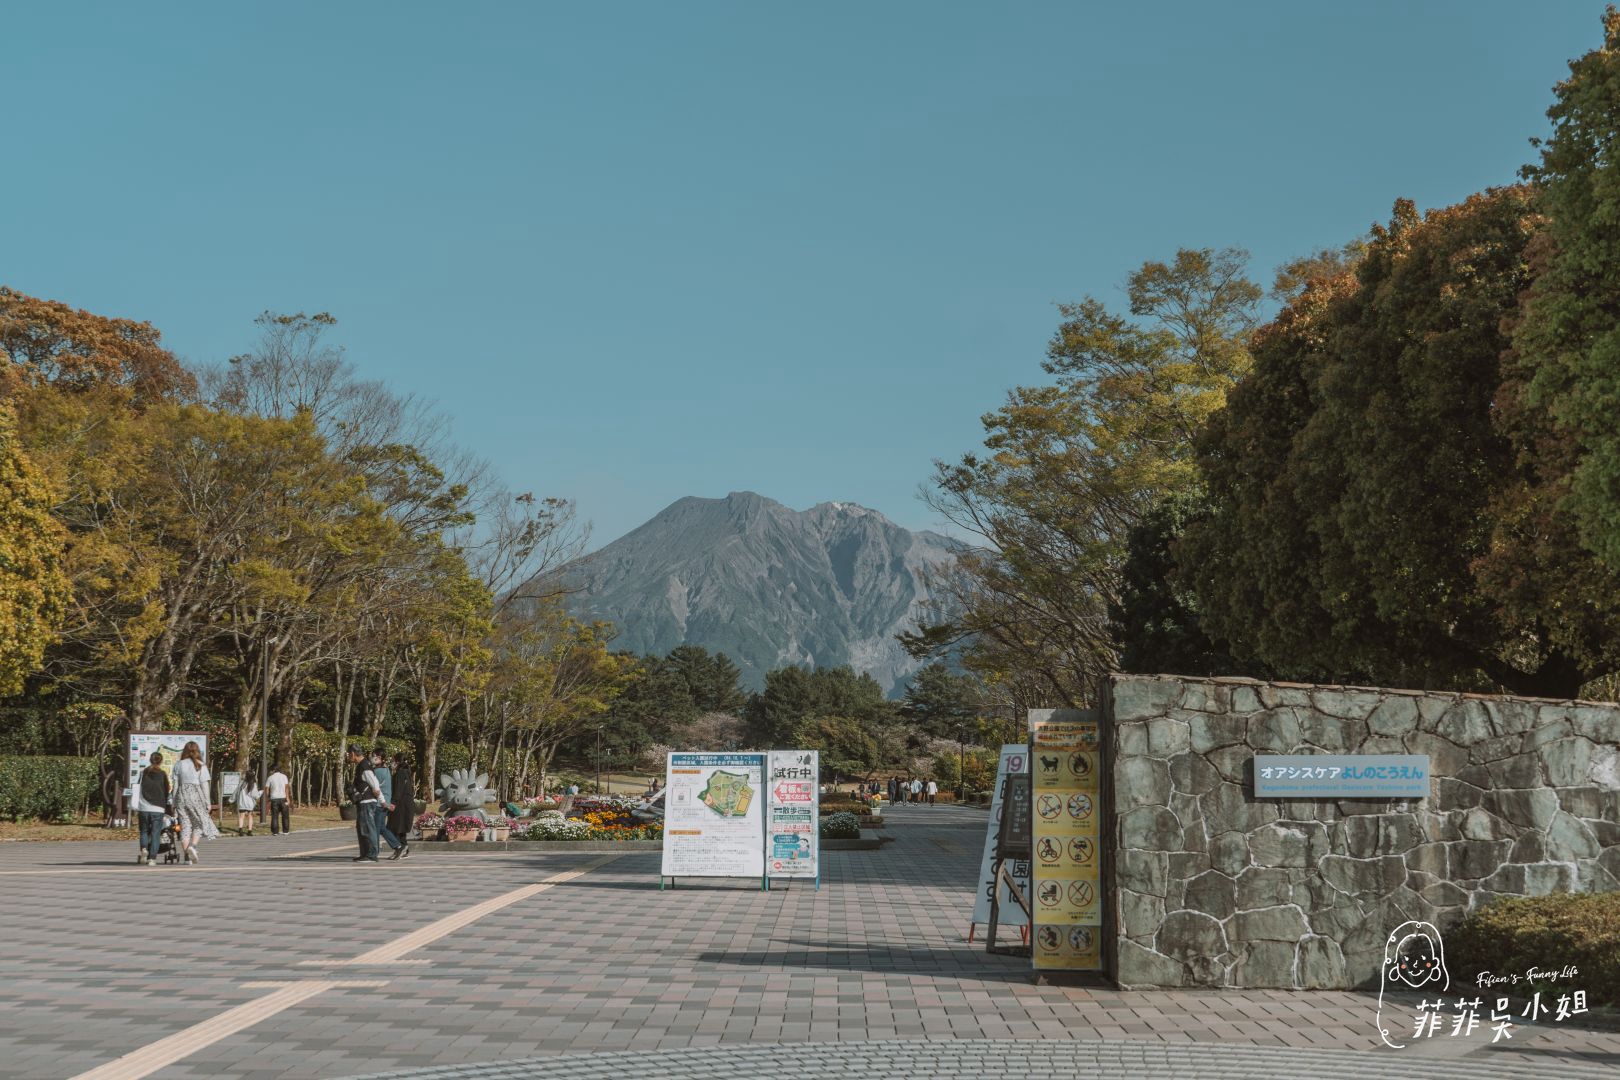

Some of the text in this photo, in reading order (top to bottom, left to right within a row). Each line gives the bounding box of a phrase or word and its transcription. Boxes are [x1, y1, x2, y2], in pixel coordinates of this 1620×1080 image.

[1004, 755, 1023, 773] 19
[774, 767, 812, 779] 試行中
